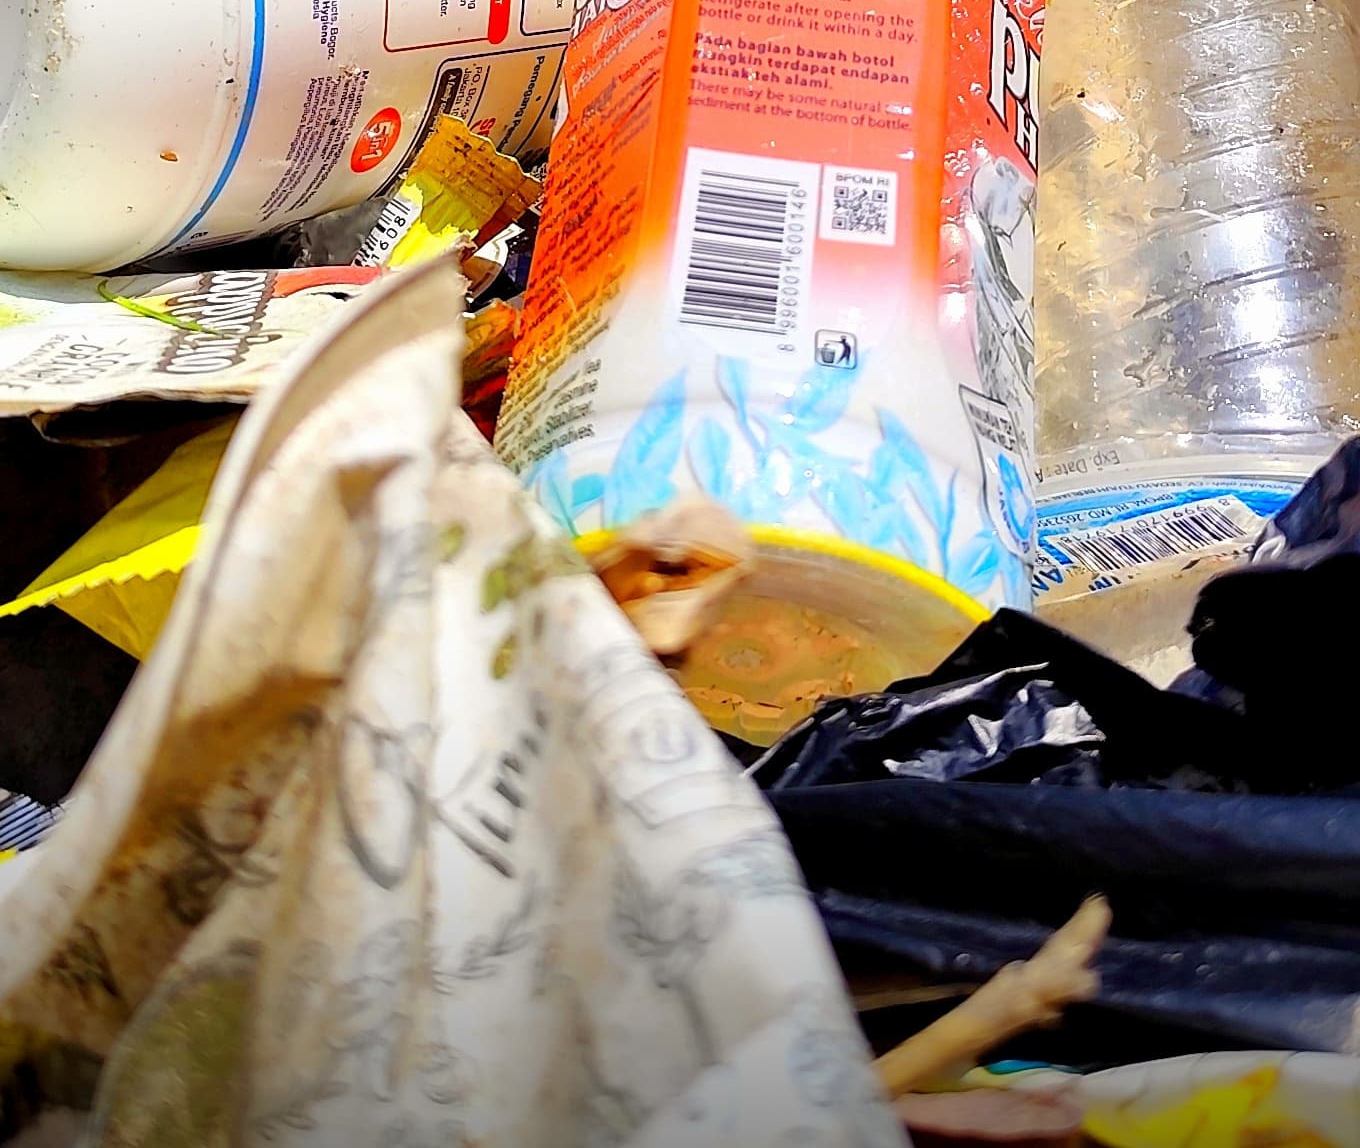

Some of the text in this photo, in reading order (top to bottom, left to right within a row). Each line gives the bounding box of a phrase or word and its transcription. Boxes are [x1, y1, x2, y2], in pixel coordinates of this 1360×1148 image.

[698, 7, 742, 21] bottle
[766, 14, 804, 28] drink
[822, 21, 870, 36] within
[785, 1, 819, 14] after
[889, 13, 914, 26] the
[737, 37, 791, 55] bagian
[796, 45, 847, 61] bawah
[852, 51, 894, 67] botol
[767, 56, 910, 85] terdapat endapan
[687, 78, 728, 94] There
[766, 88, 784, 100] be
[770, 104, 792, 116] the
[796, 106, 849, 123] bottom
[362, 216, 407, 268] 1608
